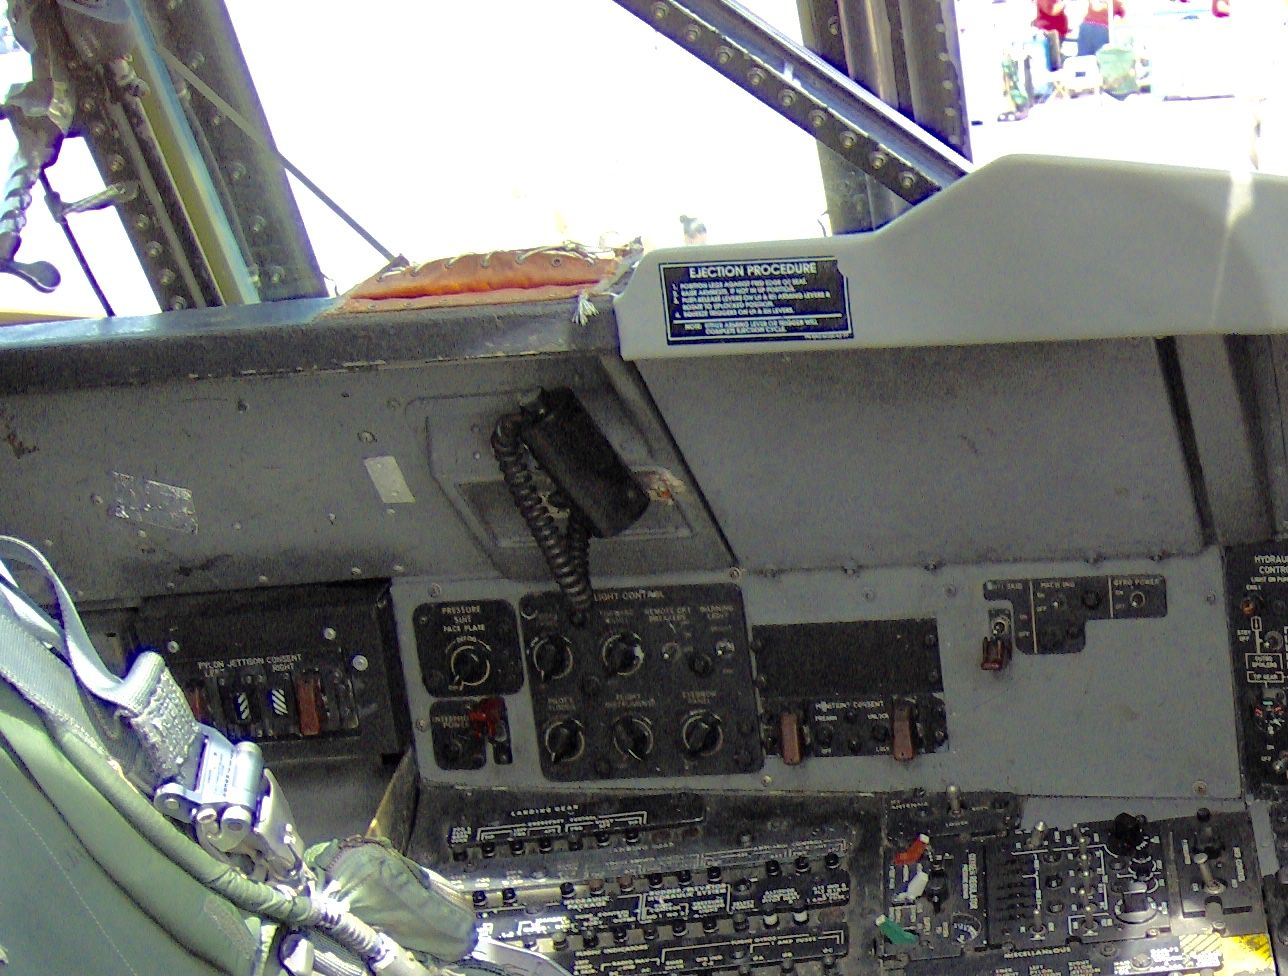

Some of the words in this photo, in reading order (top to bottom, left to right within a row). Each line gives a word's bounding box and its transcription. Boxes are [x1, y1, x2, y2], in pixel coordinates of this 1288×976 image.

[689, 266, 744, 279] EJECTION
[747, 262, 817, 276] PROCEDURE
[593, 592, 619, 602] LIGHT
[441, 605, 481, 615] PRESSURE
[510, 806, 552, 817] LANDING
[554, 804, 579, 813] GEAR
